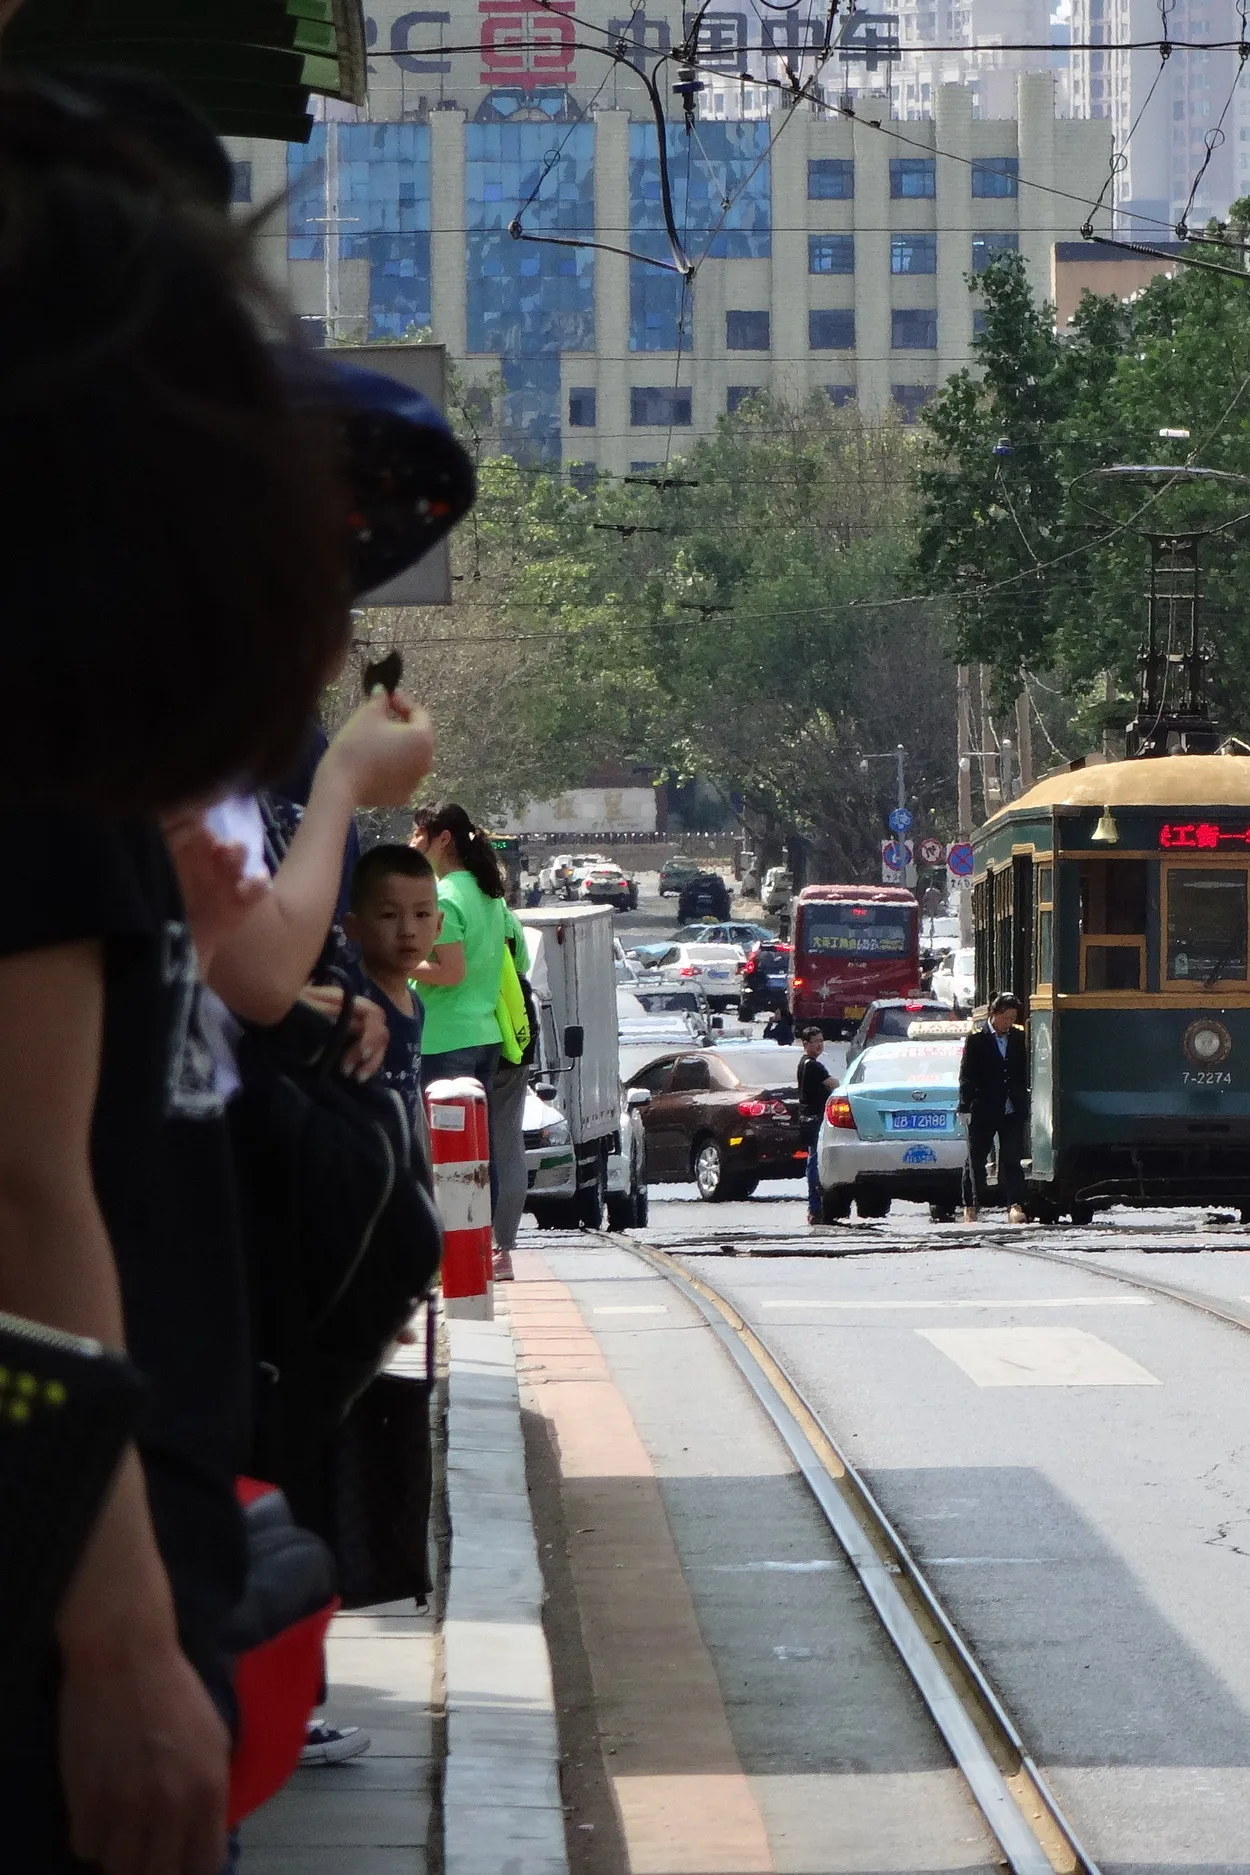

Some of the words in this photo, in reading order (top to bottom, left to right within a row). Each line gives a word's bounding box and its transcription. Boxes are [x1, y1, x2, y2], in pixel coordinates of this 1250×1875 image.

[608, 8, 901, 75] 中国中车
[1181, 1072, 1232, 1085] 7-2274
